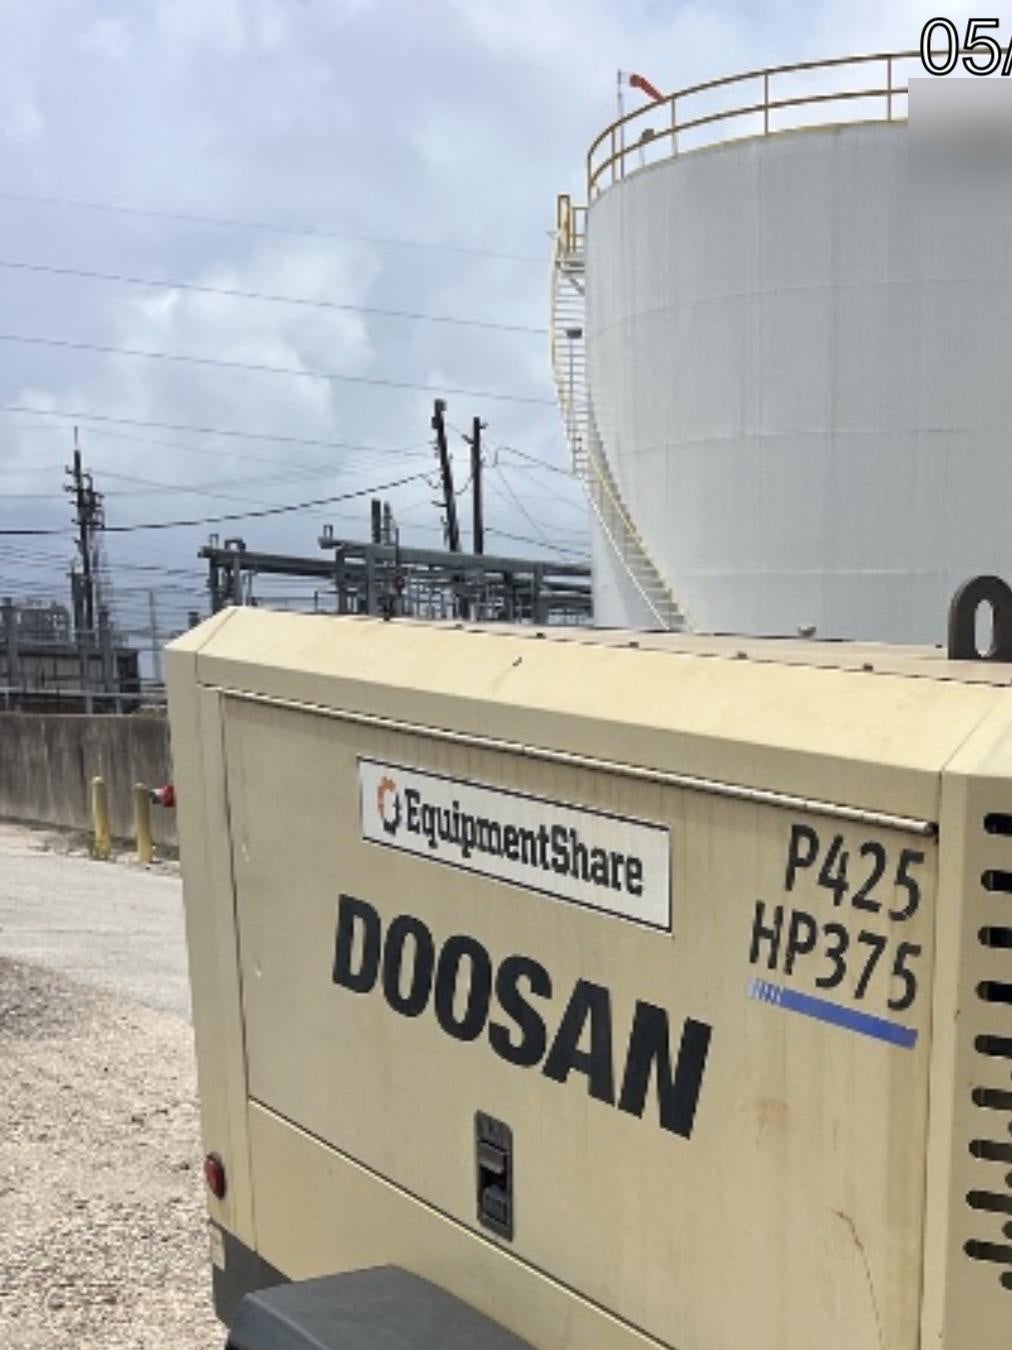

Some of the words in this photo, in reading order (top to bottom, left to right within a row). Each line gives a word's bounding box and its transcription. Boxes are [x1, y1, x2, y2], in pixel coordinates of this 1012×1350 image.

[403, 788, 644, 896] EquipmentShare
[784, 825, 926, 922] P425
[749, 900, 922, 1011] HP375
[332, 893, 712, 1139] DOOSAN
